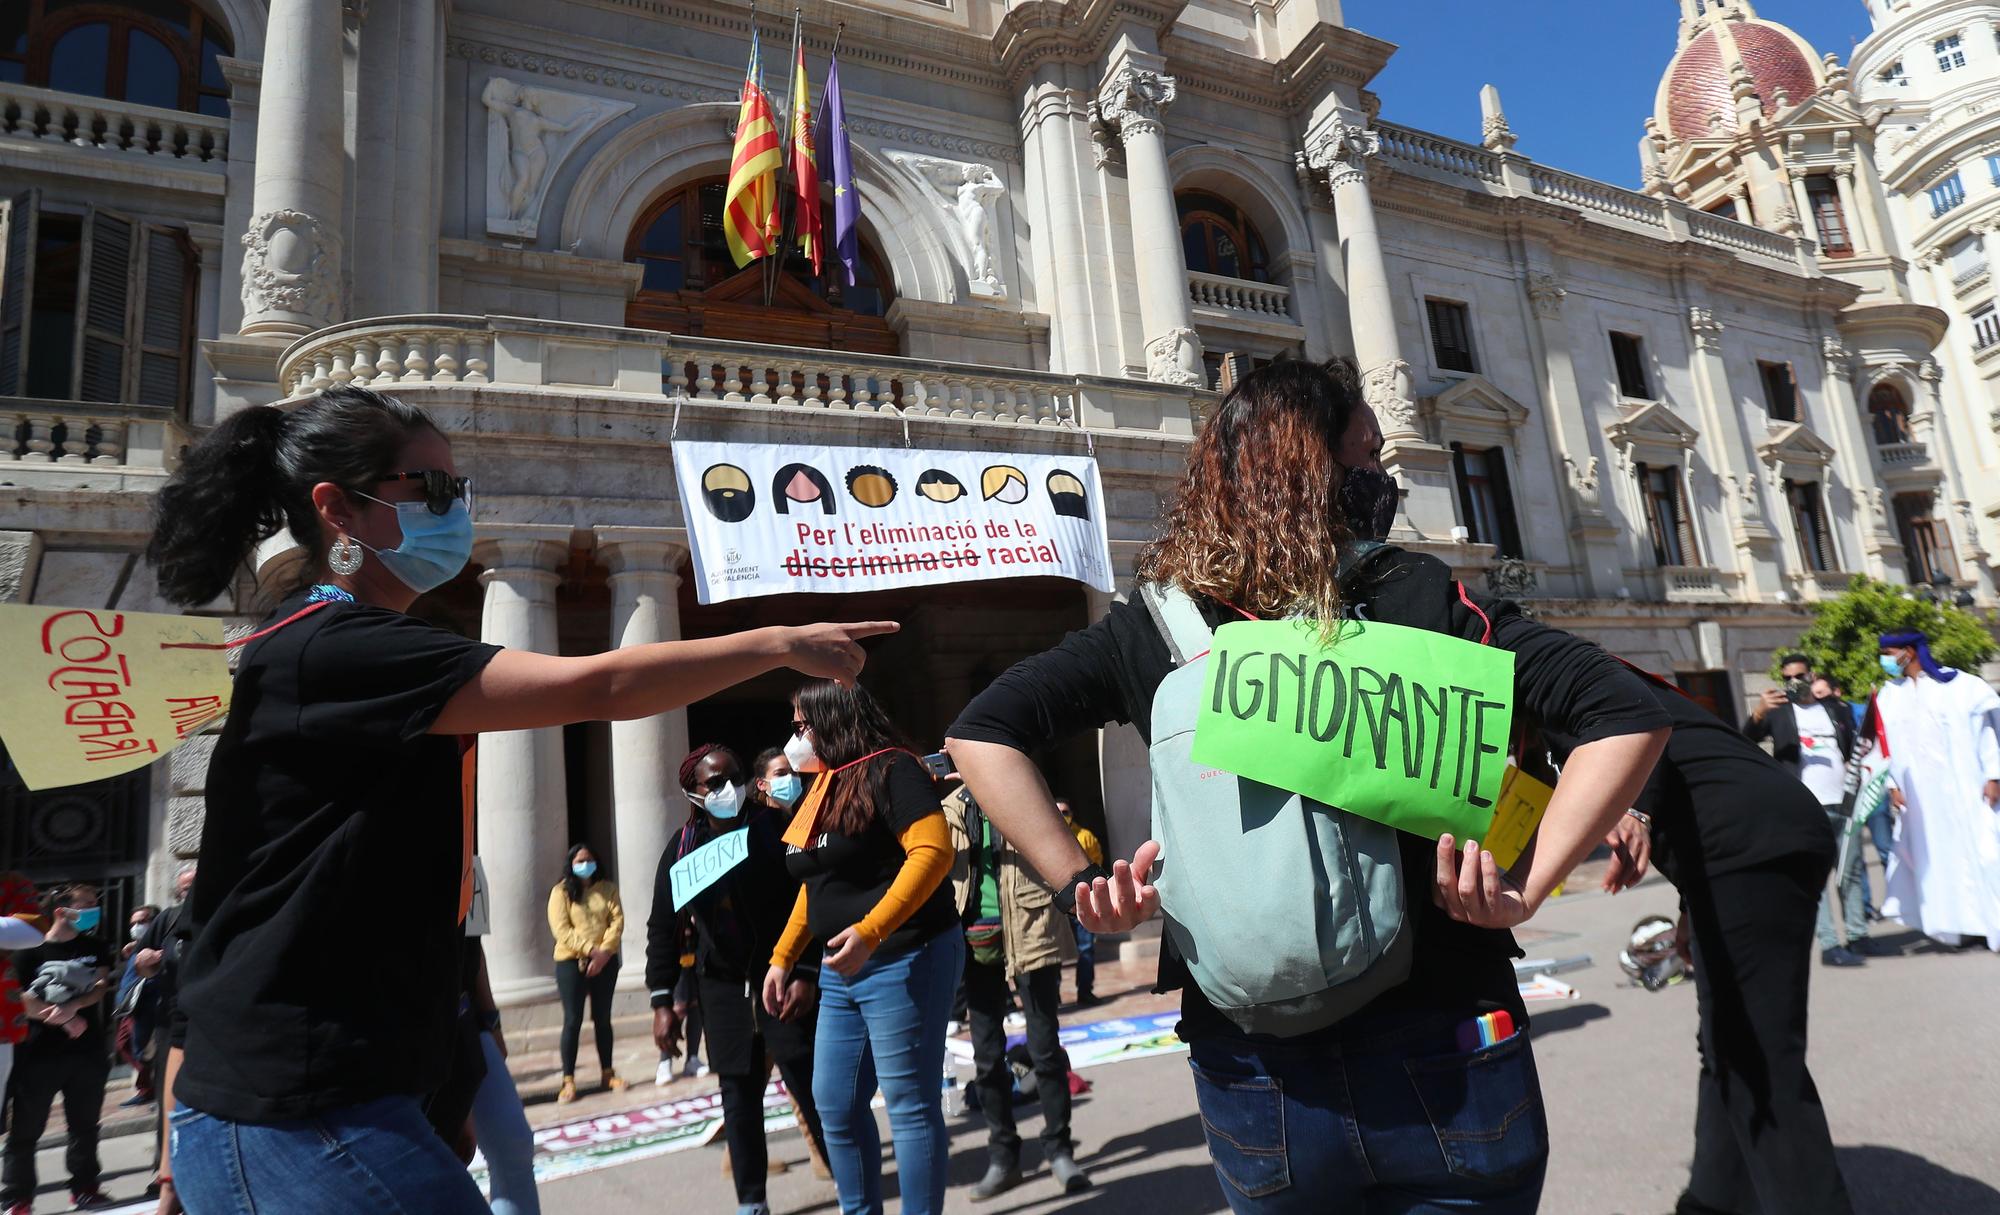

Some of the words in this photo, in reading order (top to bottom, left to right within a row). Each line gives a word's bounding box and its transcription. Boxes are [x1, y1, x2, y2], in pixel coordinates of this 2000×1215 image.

[796, 522, 837, 546] Per
[844, 519, 978, 546] l'eliminació
[984, 519, 1011, 539] de
[1014, 518, 1038, 538] la
[785, 542, 980, 578] discriminació
[986, 539, 1063, 566] racial
[1212, 649, 1506, 808] IGNORANTE
[675, 832, 743, 898] NEGRA
